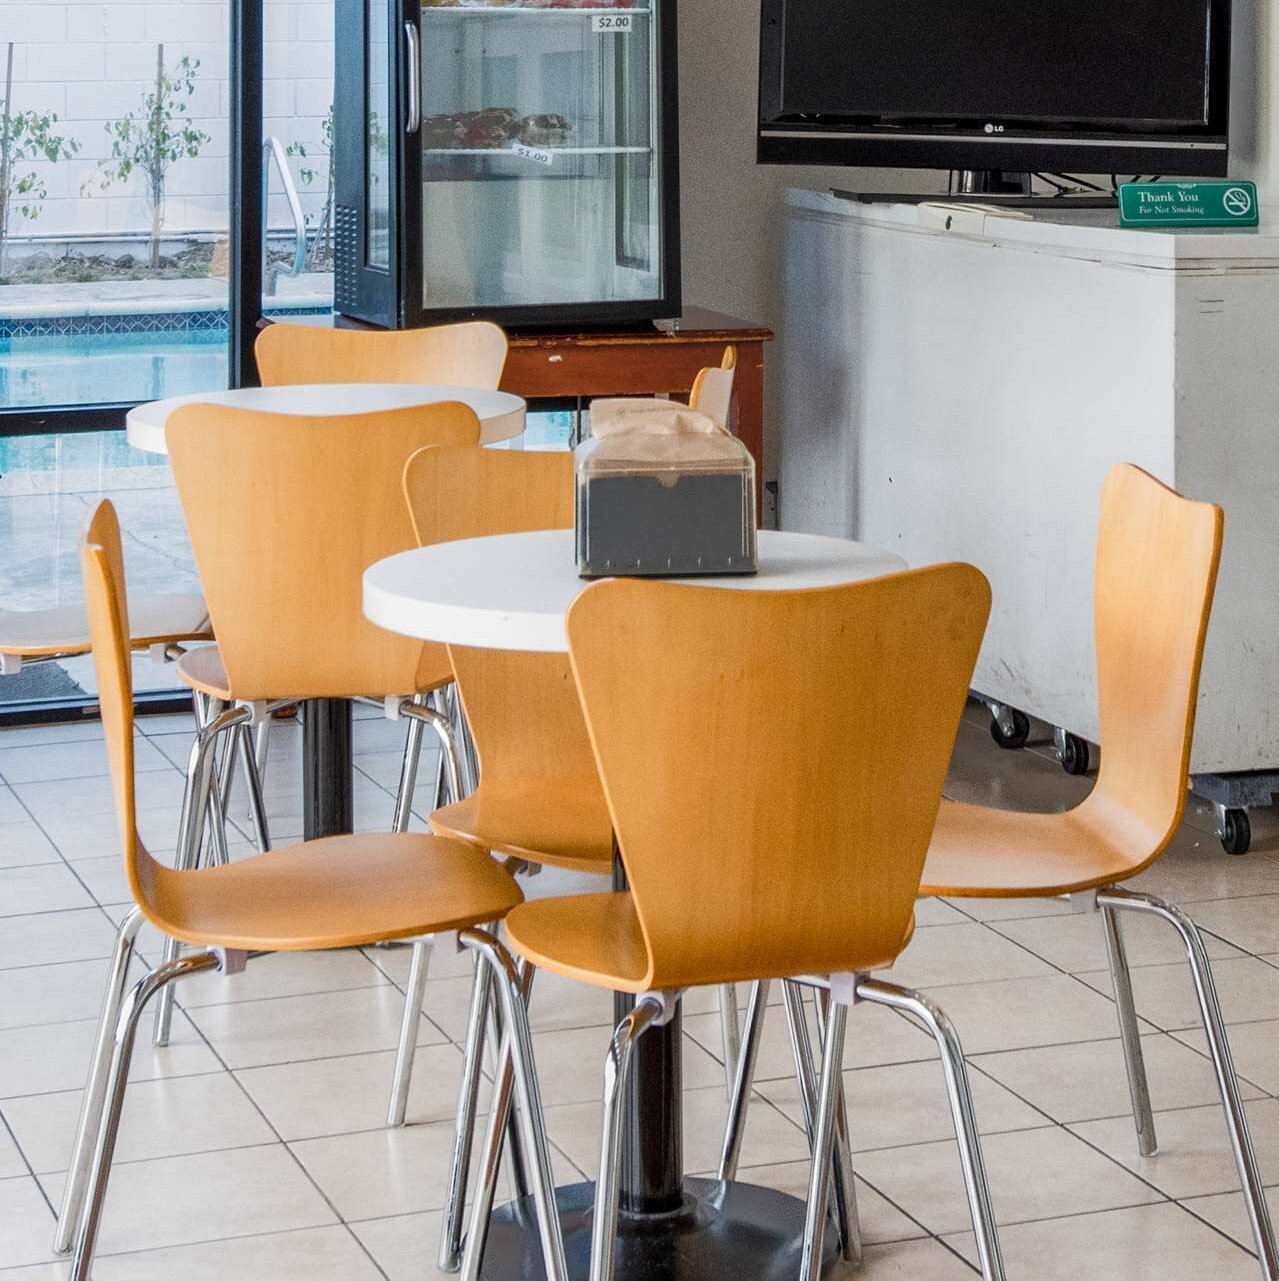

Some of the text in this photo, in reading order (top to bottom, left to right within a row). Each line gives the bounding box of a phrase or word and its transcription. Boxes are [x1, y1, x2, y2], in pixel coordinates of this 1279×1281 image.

[599, 17, 629, 28] $2.00
[518, 148, 548, 163] $1.00
[1138, 191, 1199, 203] Thank You
[1139, 205, 1205, 215] For Not Smoking
